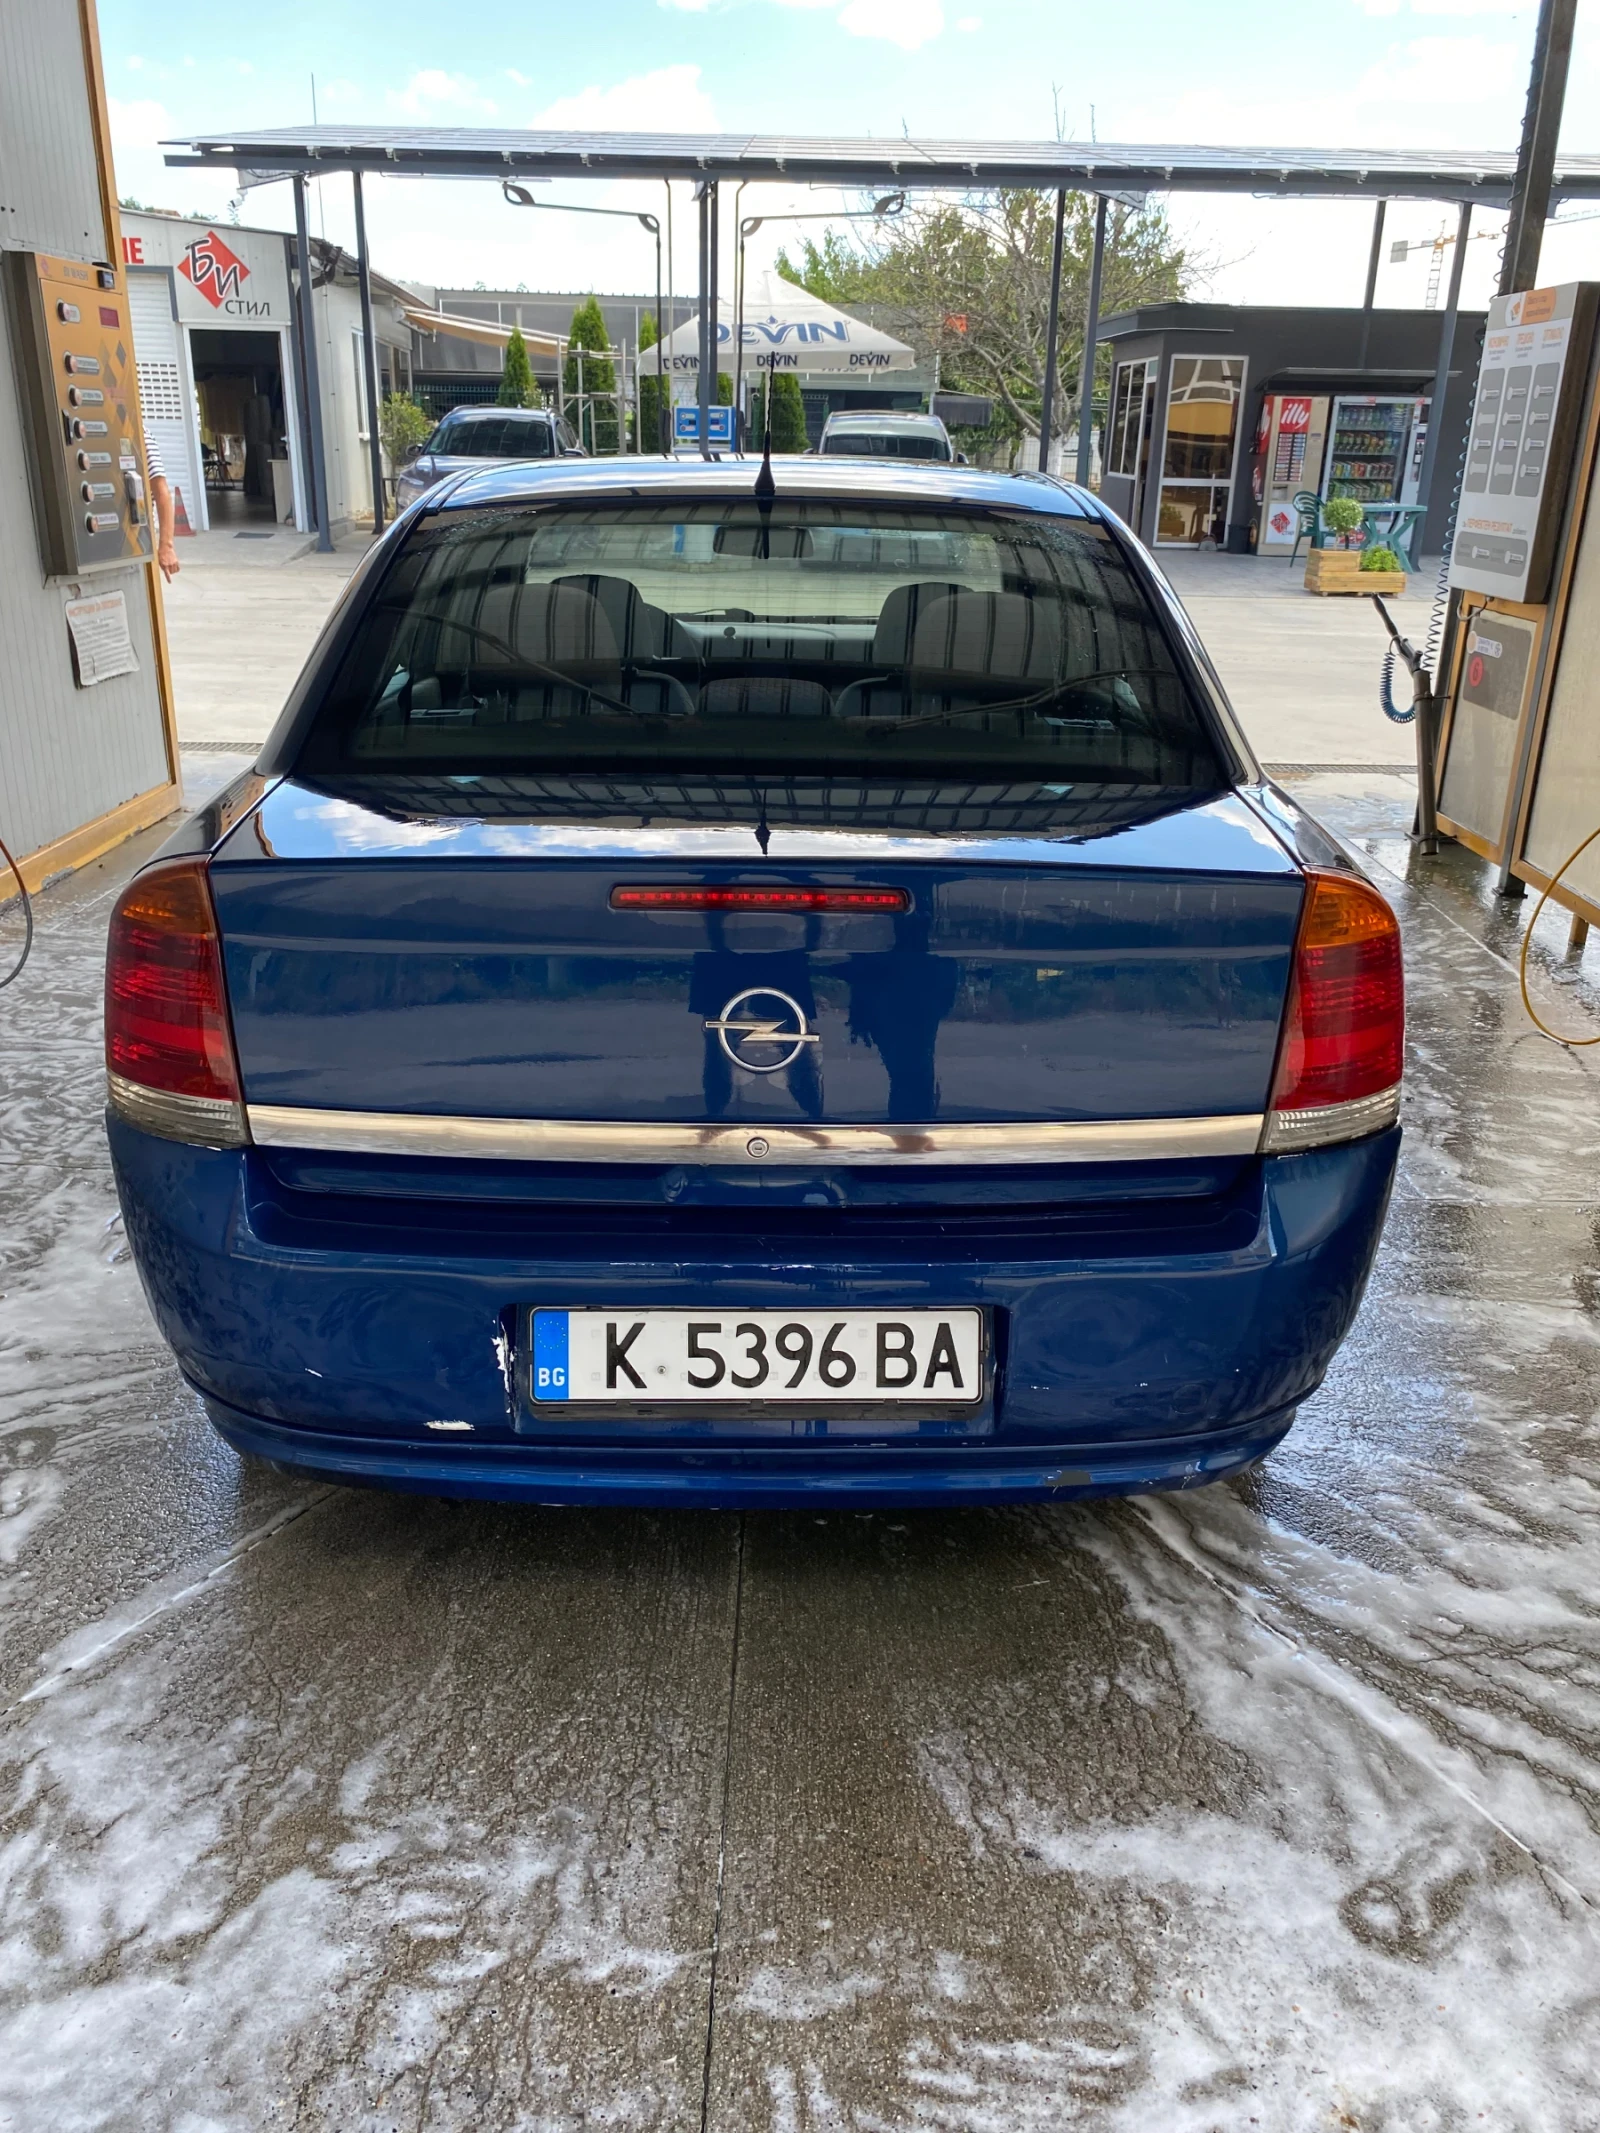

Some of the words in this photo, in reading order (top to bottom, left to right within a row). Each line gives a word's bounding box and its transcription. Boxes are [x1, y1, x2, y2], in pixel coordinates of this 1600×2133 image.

[185, 237, 241, 298] БИ
[225, 299, 271, 316] СТИЛ
[757, 354, 798, 367] DEVIN
[849, 353, 891, 366] DEVIN
[1281, 403, 1310, 430] illy
[605, 1322, 648, 1389] K
[687, 1322, 857, 1389] 5396
[876, 1322, 965, 1389] BA
[538, 1366, 566, 1387] BG
